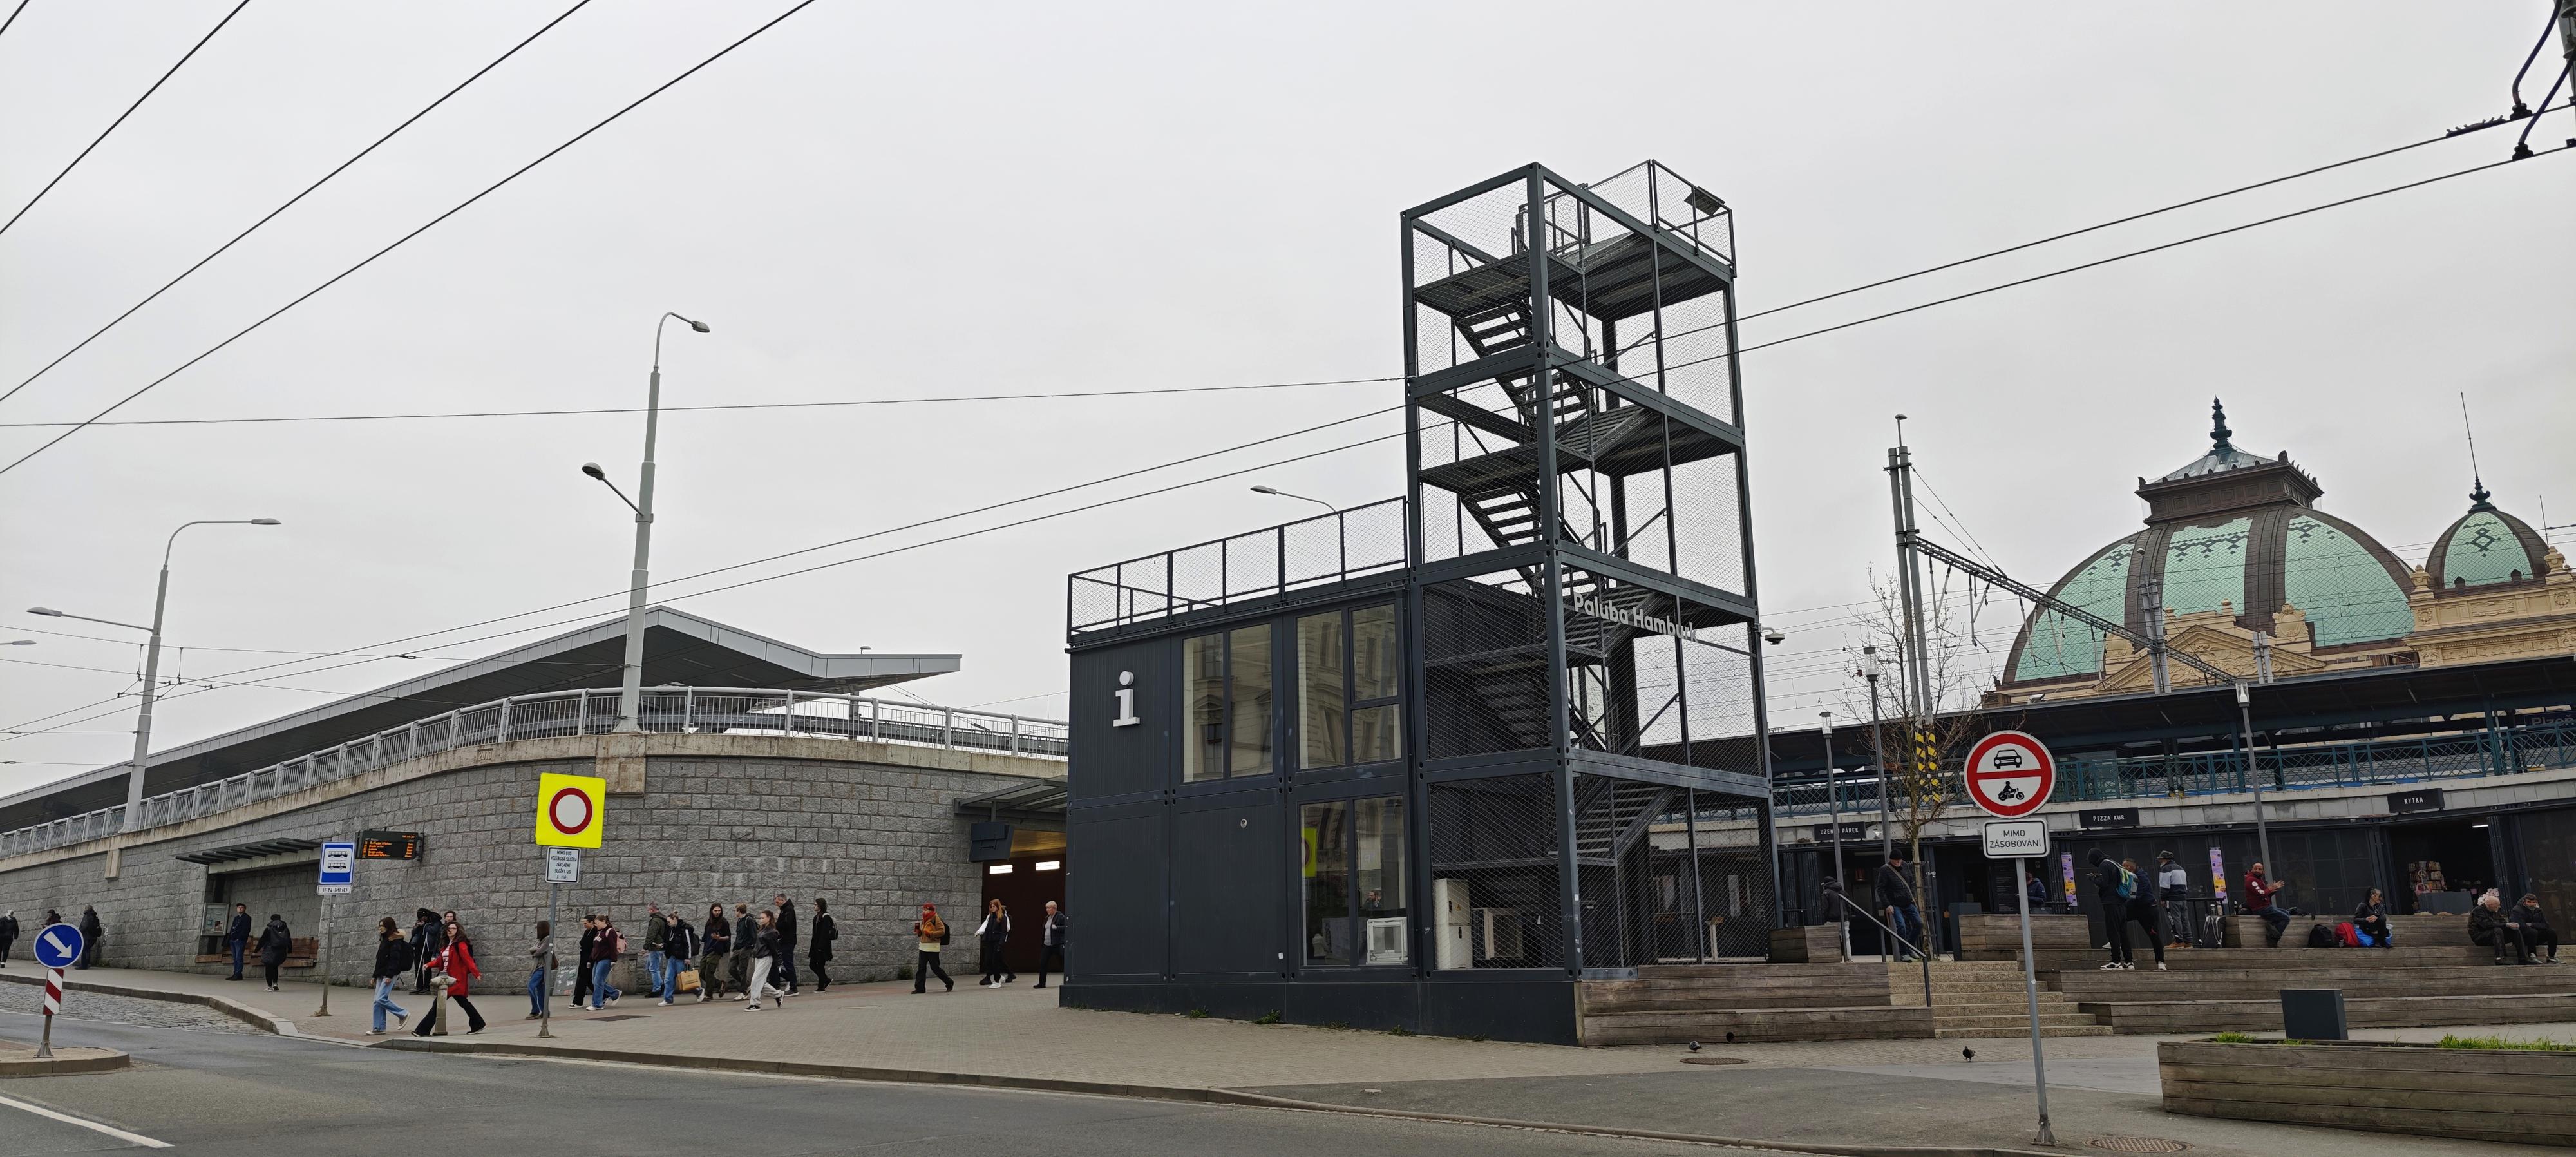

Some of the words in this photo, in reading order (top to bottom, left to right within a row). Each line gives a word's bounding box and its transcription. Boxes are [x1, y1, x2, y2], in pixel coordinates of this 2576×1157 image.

[1573, 591, 1629, 624] Paluba
[1633, 607, 1698, 643] Hamburk
[1989, 838, 2041, 848] ZÁSOBOVÁNÍ
